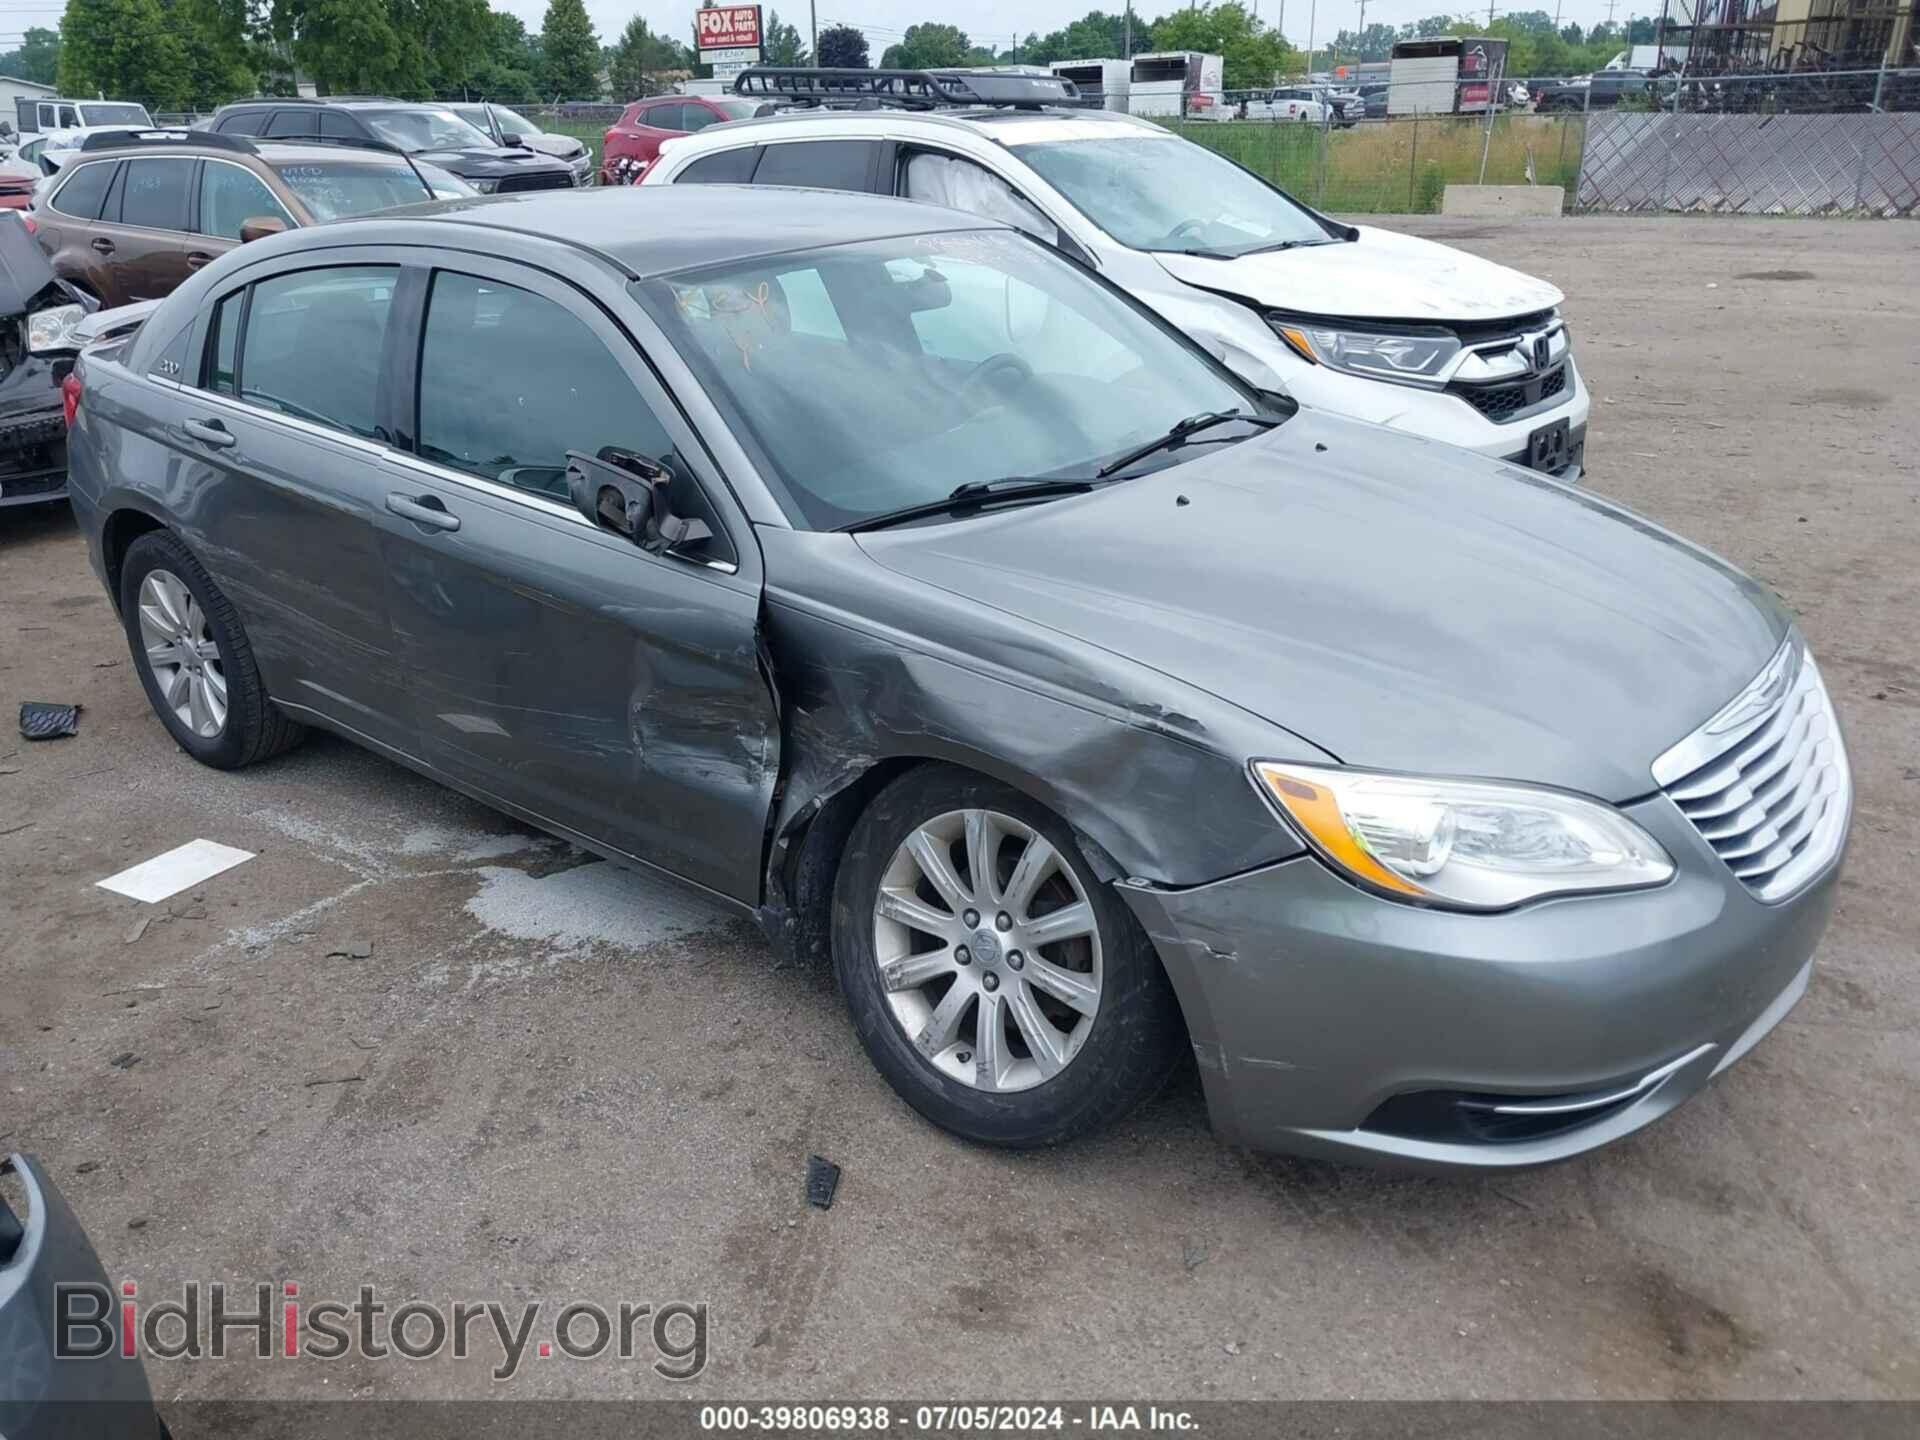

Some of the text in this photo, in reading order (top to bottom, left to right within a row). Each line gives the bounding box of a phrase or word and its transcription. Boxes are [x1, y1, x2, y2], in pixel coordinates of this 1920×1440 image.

[699, 9, 753, 34] FOX AUTO
[735, 20, 756, 31] PARTS
